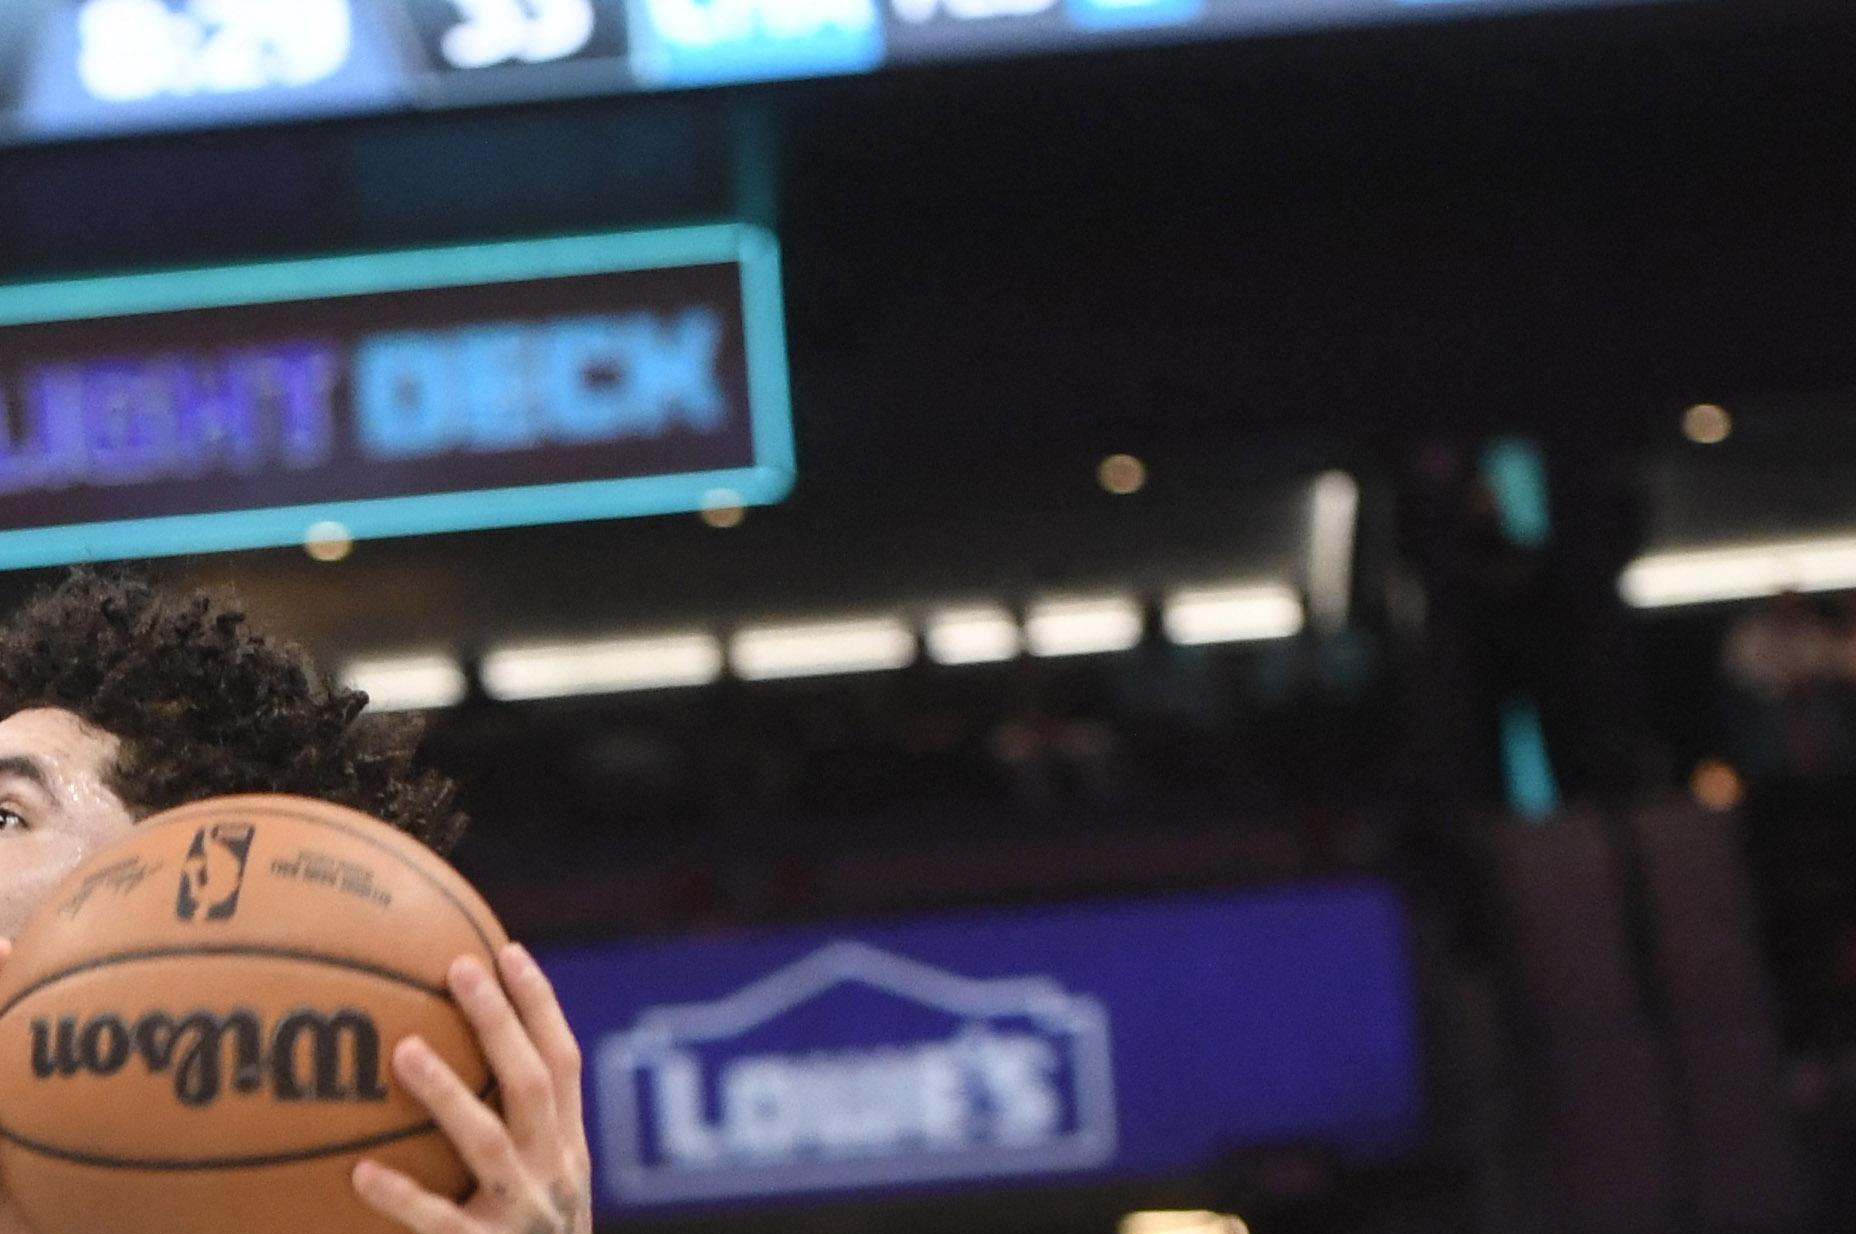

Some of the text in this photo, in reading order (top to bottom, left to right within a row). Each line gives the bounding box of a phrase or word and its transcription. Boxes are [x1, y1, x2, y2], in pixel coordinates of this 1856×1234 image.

[357, 308, 725, 458] DECK
[30, 1008, 388, 1108] Wilson
[652, 1022, 1062, 1166] LOWE'S
